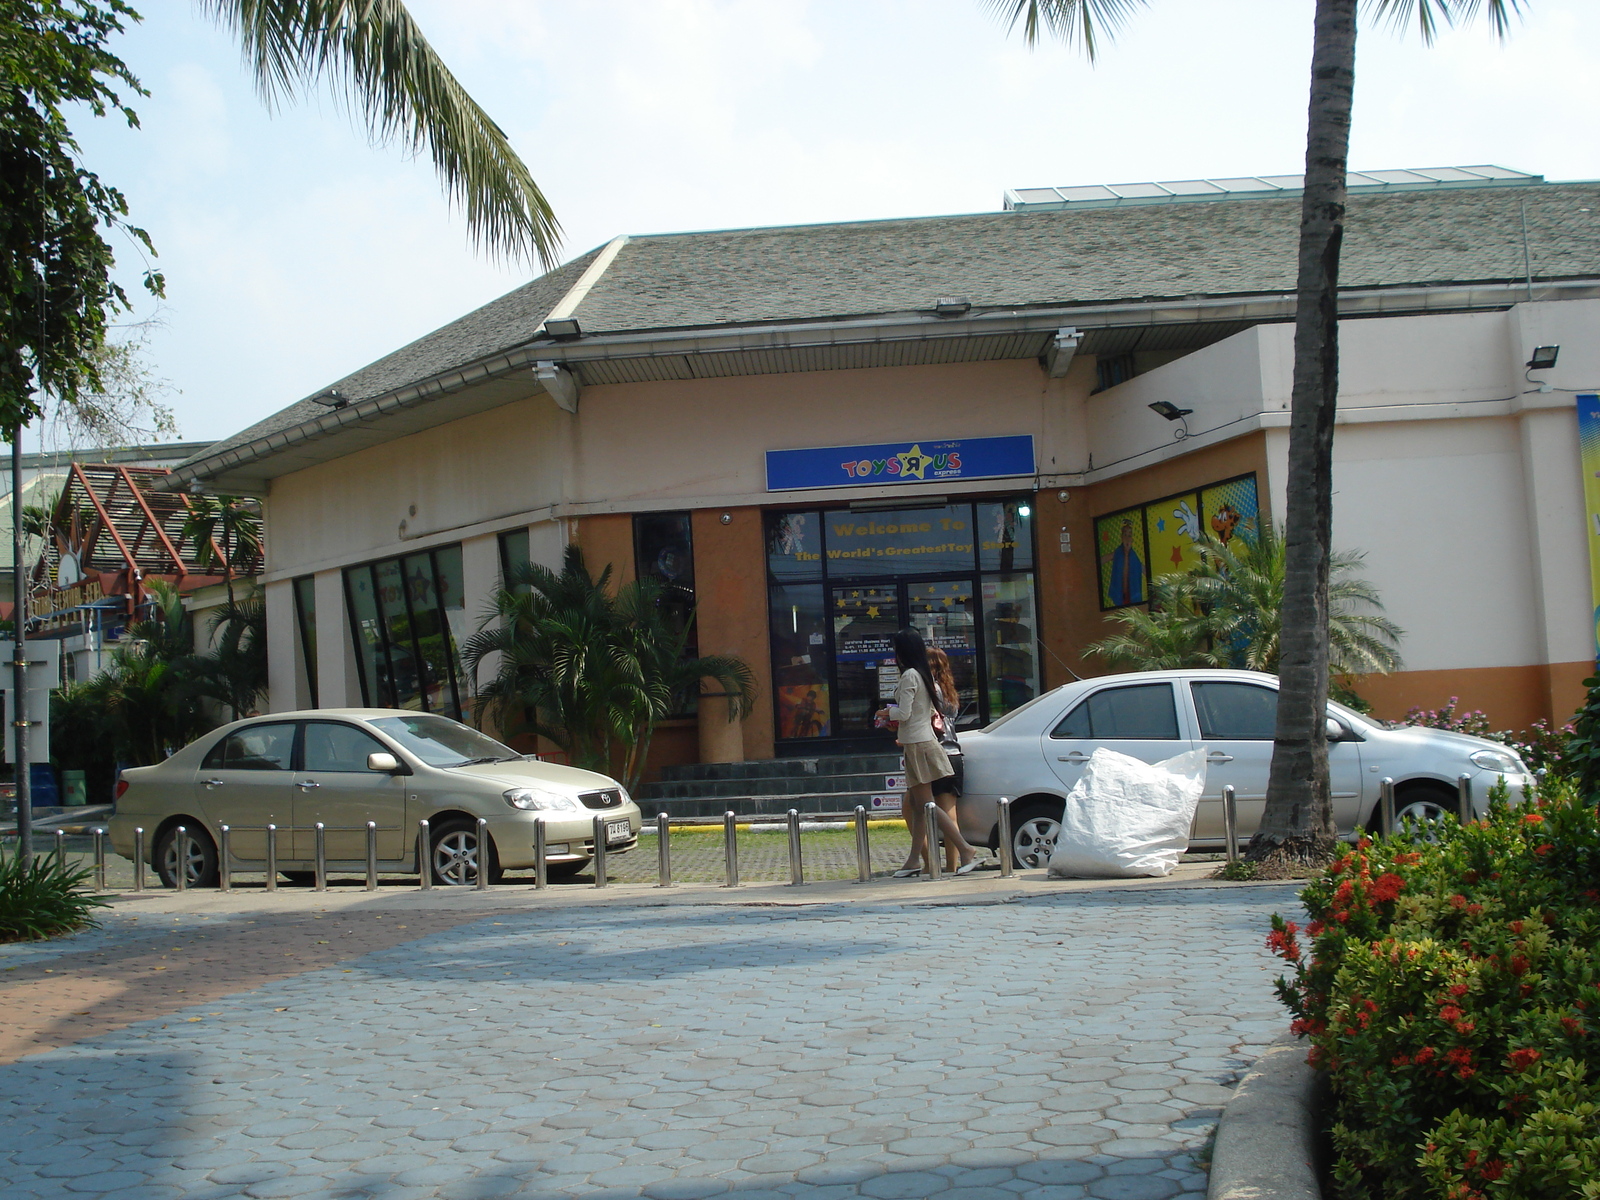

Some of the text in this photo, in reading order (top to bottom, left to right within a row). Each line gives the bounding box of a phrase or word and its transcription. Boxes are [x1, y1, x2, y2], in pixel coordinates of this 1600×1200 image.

[842, 457, 900, 477] TOYS
[933, 453, 962, 471] US
[934, 469, 962, 477] express
[833, 518, 966, 538] Welcome To
[795, 551, 820, 562] The
[827, 547, 882, 560] World's
[982, 540, 1019, 551] Store
